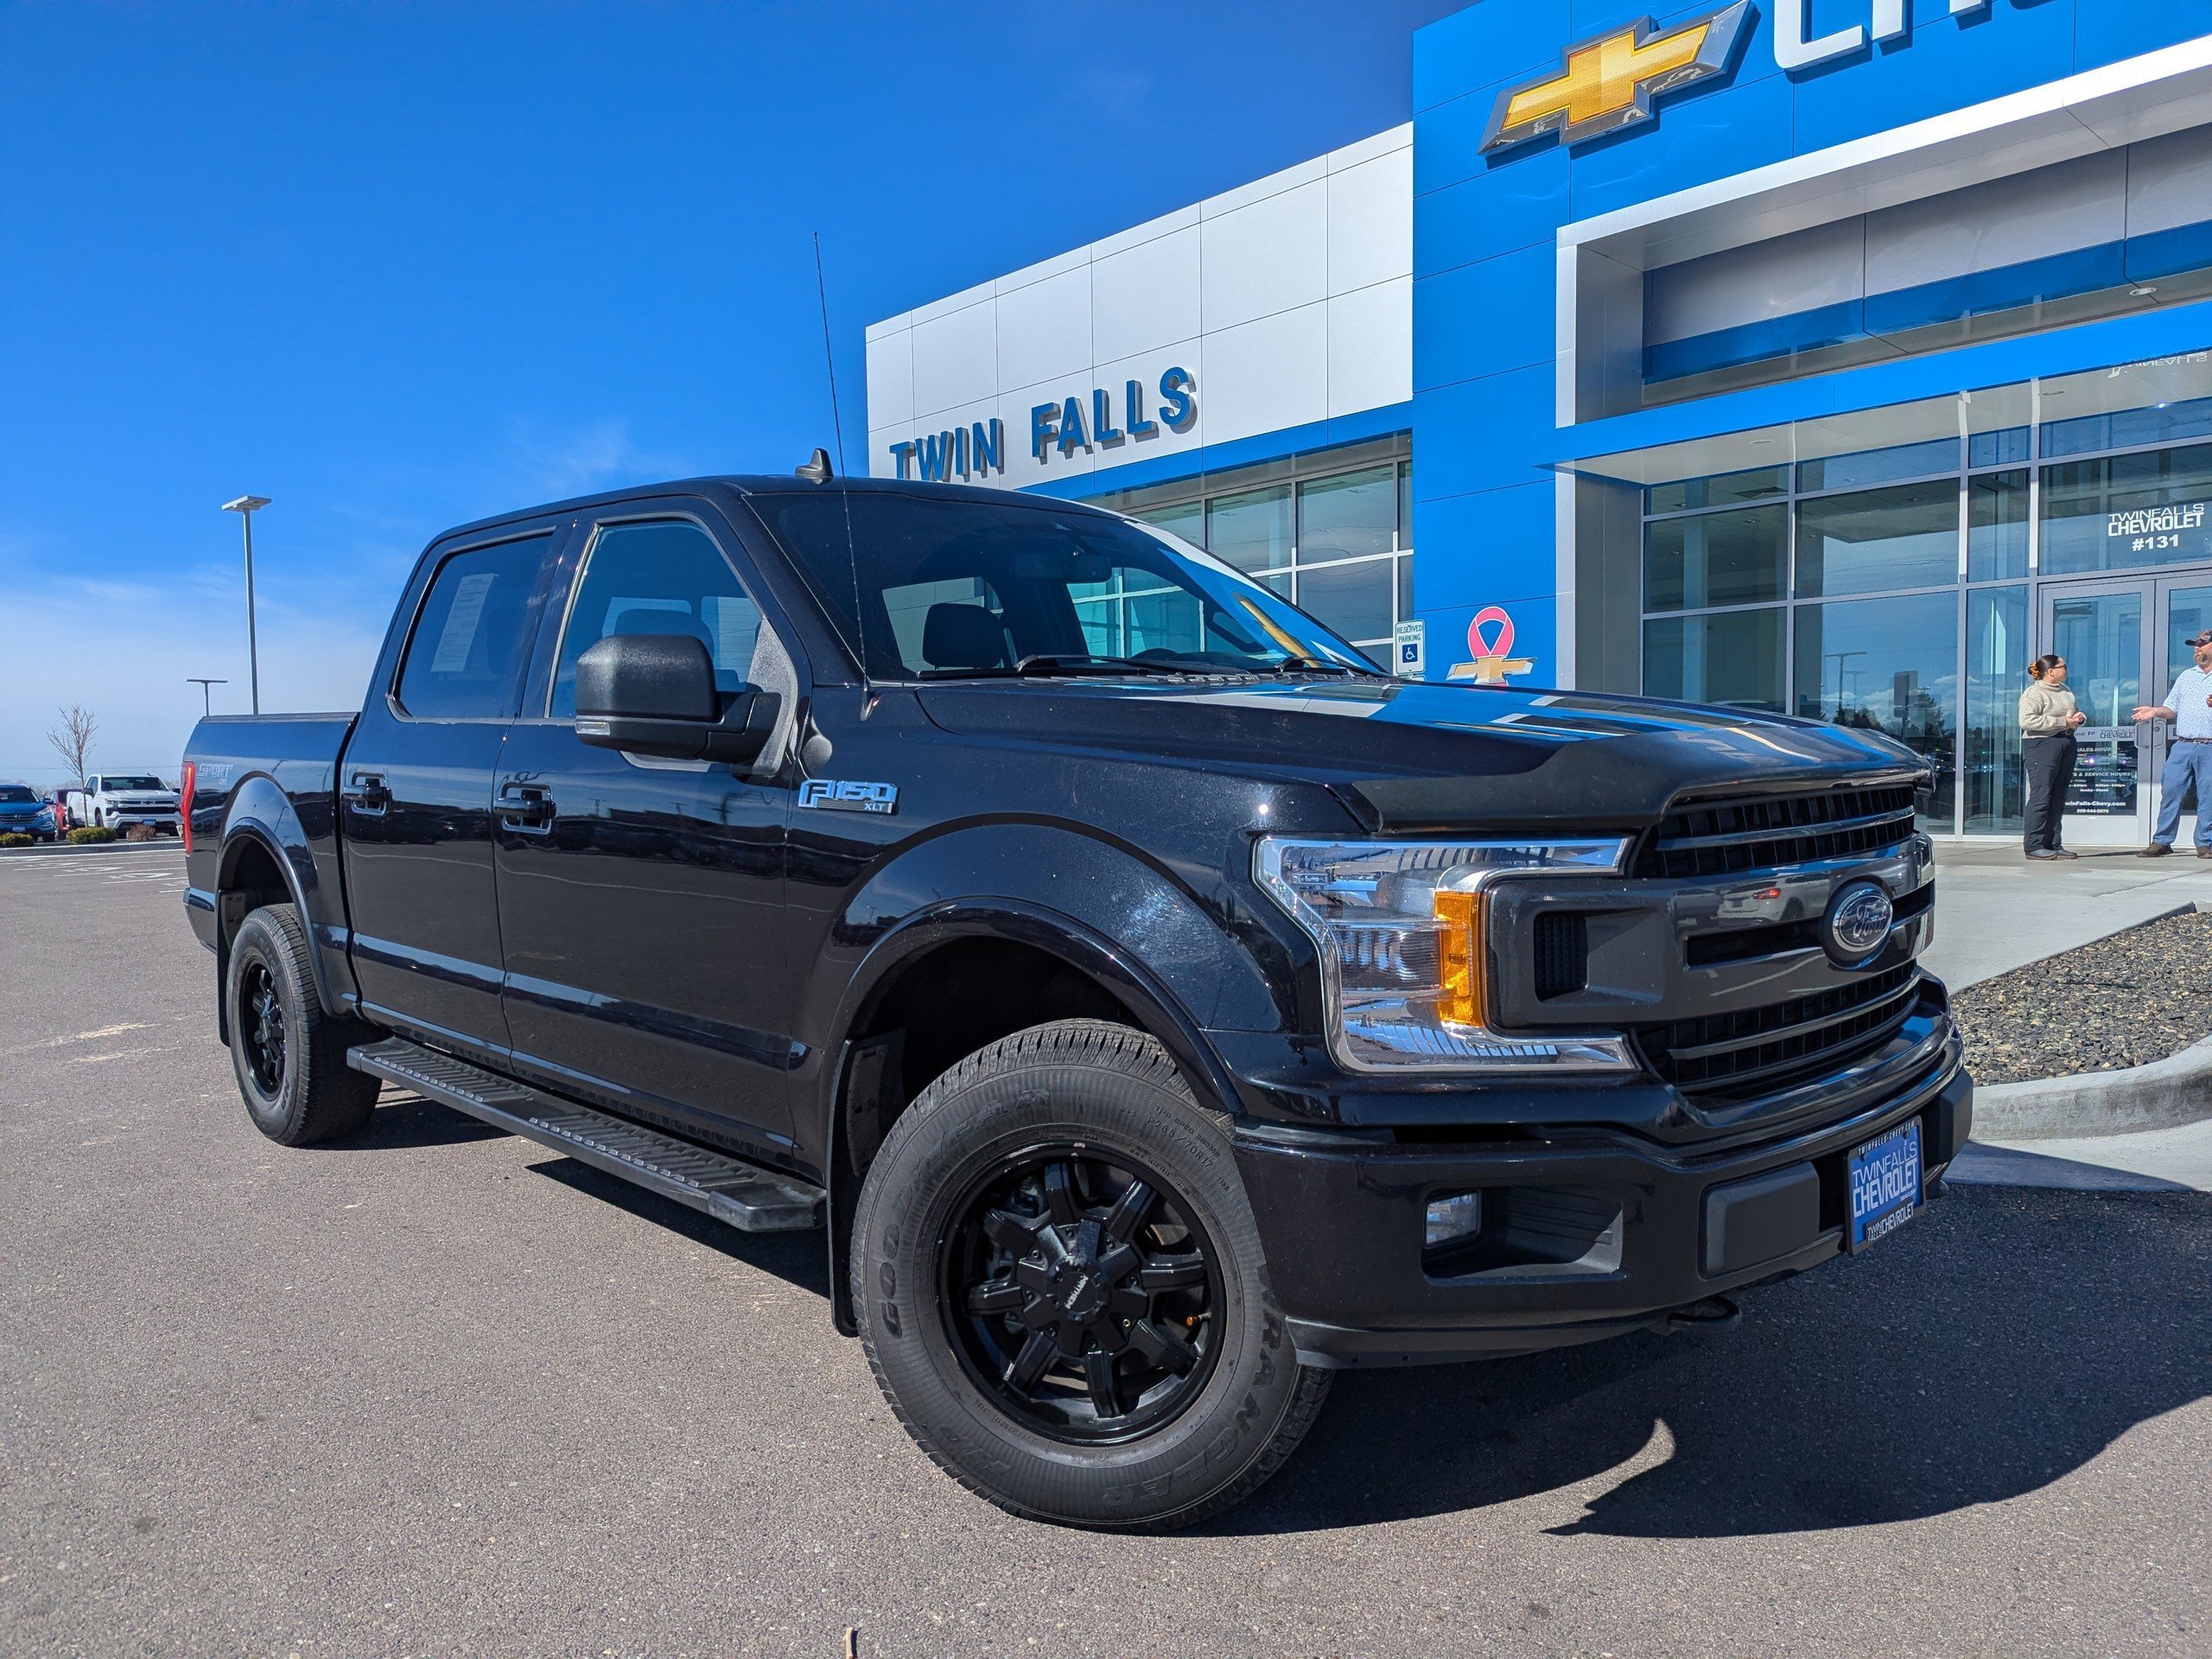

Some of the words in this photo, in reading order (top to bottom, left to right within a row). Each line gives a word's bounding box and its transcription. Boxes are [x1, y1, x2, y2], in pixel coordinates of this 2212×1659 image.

[889, 417, 1005, 484] TWIN
[1031, 365, 1198, 465] FALLS
[2108, 503, 2204, 522] TWINFALLS
[2108, 512, 2204, 537] CHEVROLET
[2132, 534, 2179, 551] #131
[1396, 625, 1423, 634] RESERVED
[1398, 634, 1421, 643] PARKING
[196, 763, 234, 779] SPORT
[864, 802, 886, 811] XLT
[1853, 901, 1887, 939] Ford
[1853, 1141, 1917, 1187] TWINFALLS
[1853, 1157, 1917, 1218] CHEVROLET
[1866, 1219, 1882, 1237] TWIN
[1881, 1201, 1914, 1235] CHEVROLET
[1065, 1274, 1089, 1309] MAYHEM
